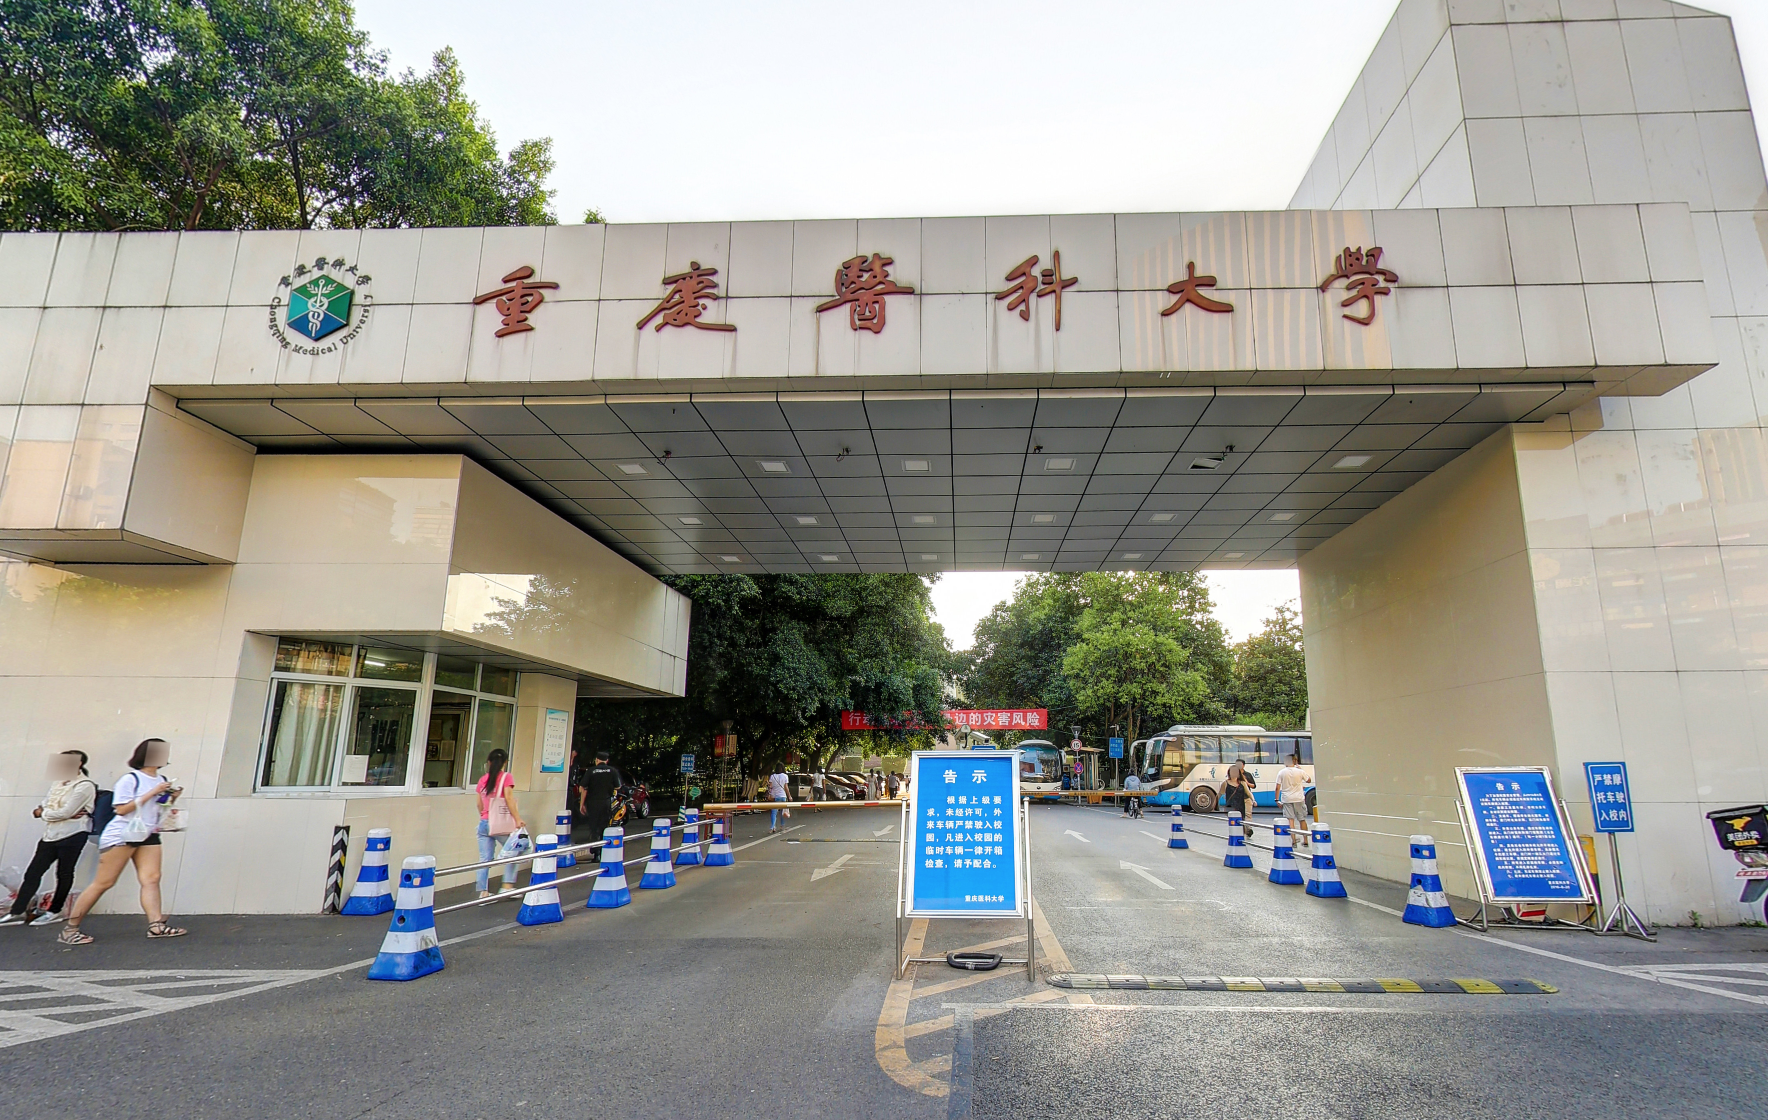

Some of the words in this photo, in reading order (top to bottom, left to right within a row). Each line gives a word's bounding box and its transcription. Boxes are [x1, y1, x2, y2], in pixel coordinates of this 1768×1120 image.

[269, 297, 291, 349] Chongqing
[292, 342, 338, 356] Medical
[340, 294, 373, 345] Universiy
[943, 770, 987, 784] 告示
[1593, 774, 1622, 786] 严禁摩
[947, 796, 1002, 804] 根据上级要
[1596, 791, 1625, 803] 托车驶
[1601, 809, 1627, 821] 入校内
[926, 820, 1003, 829] 来车辆严禁驶入校
[925, 846, 1003, 855] 临时车辆一律开箱
